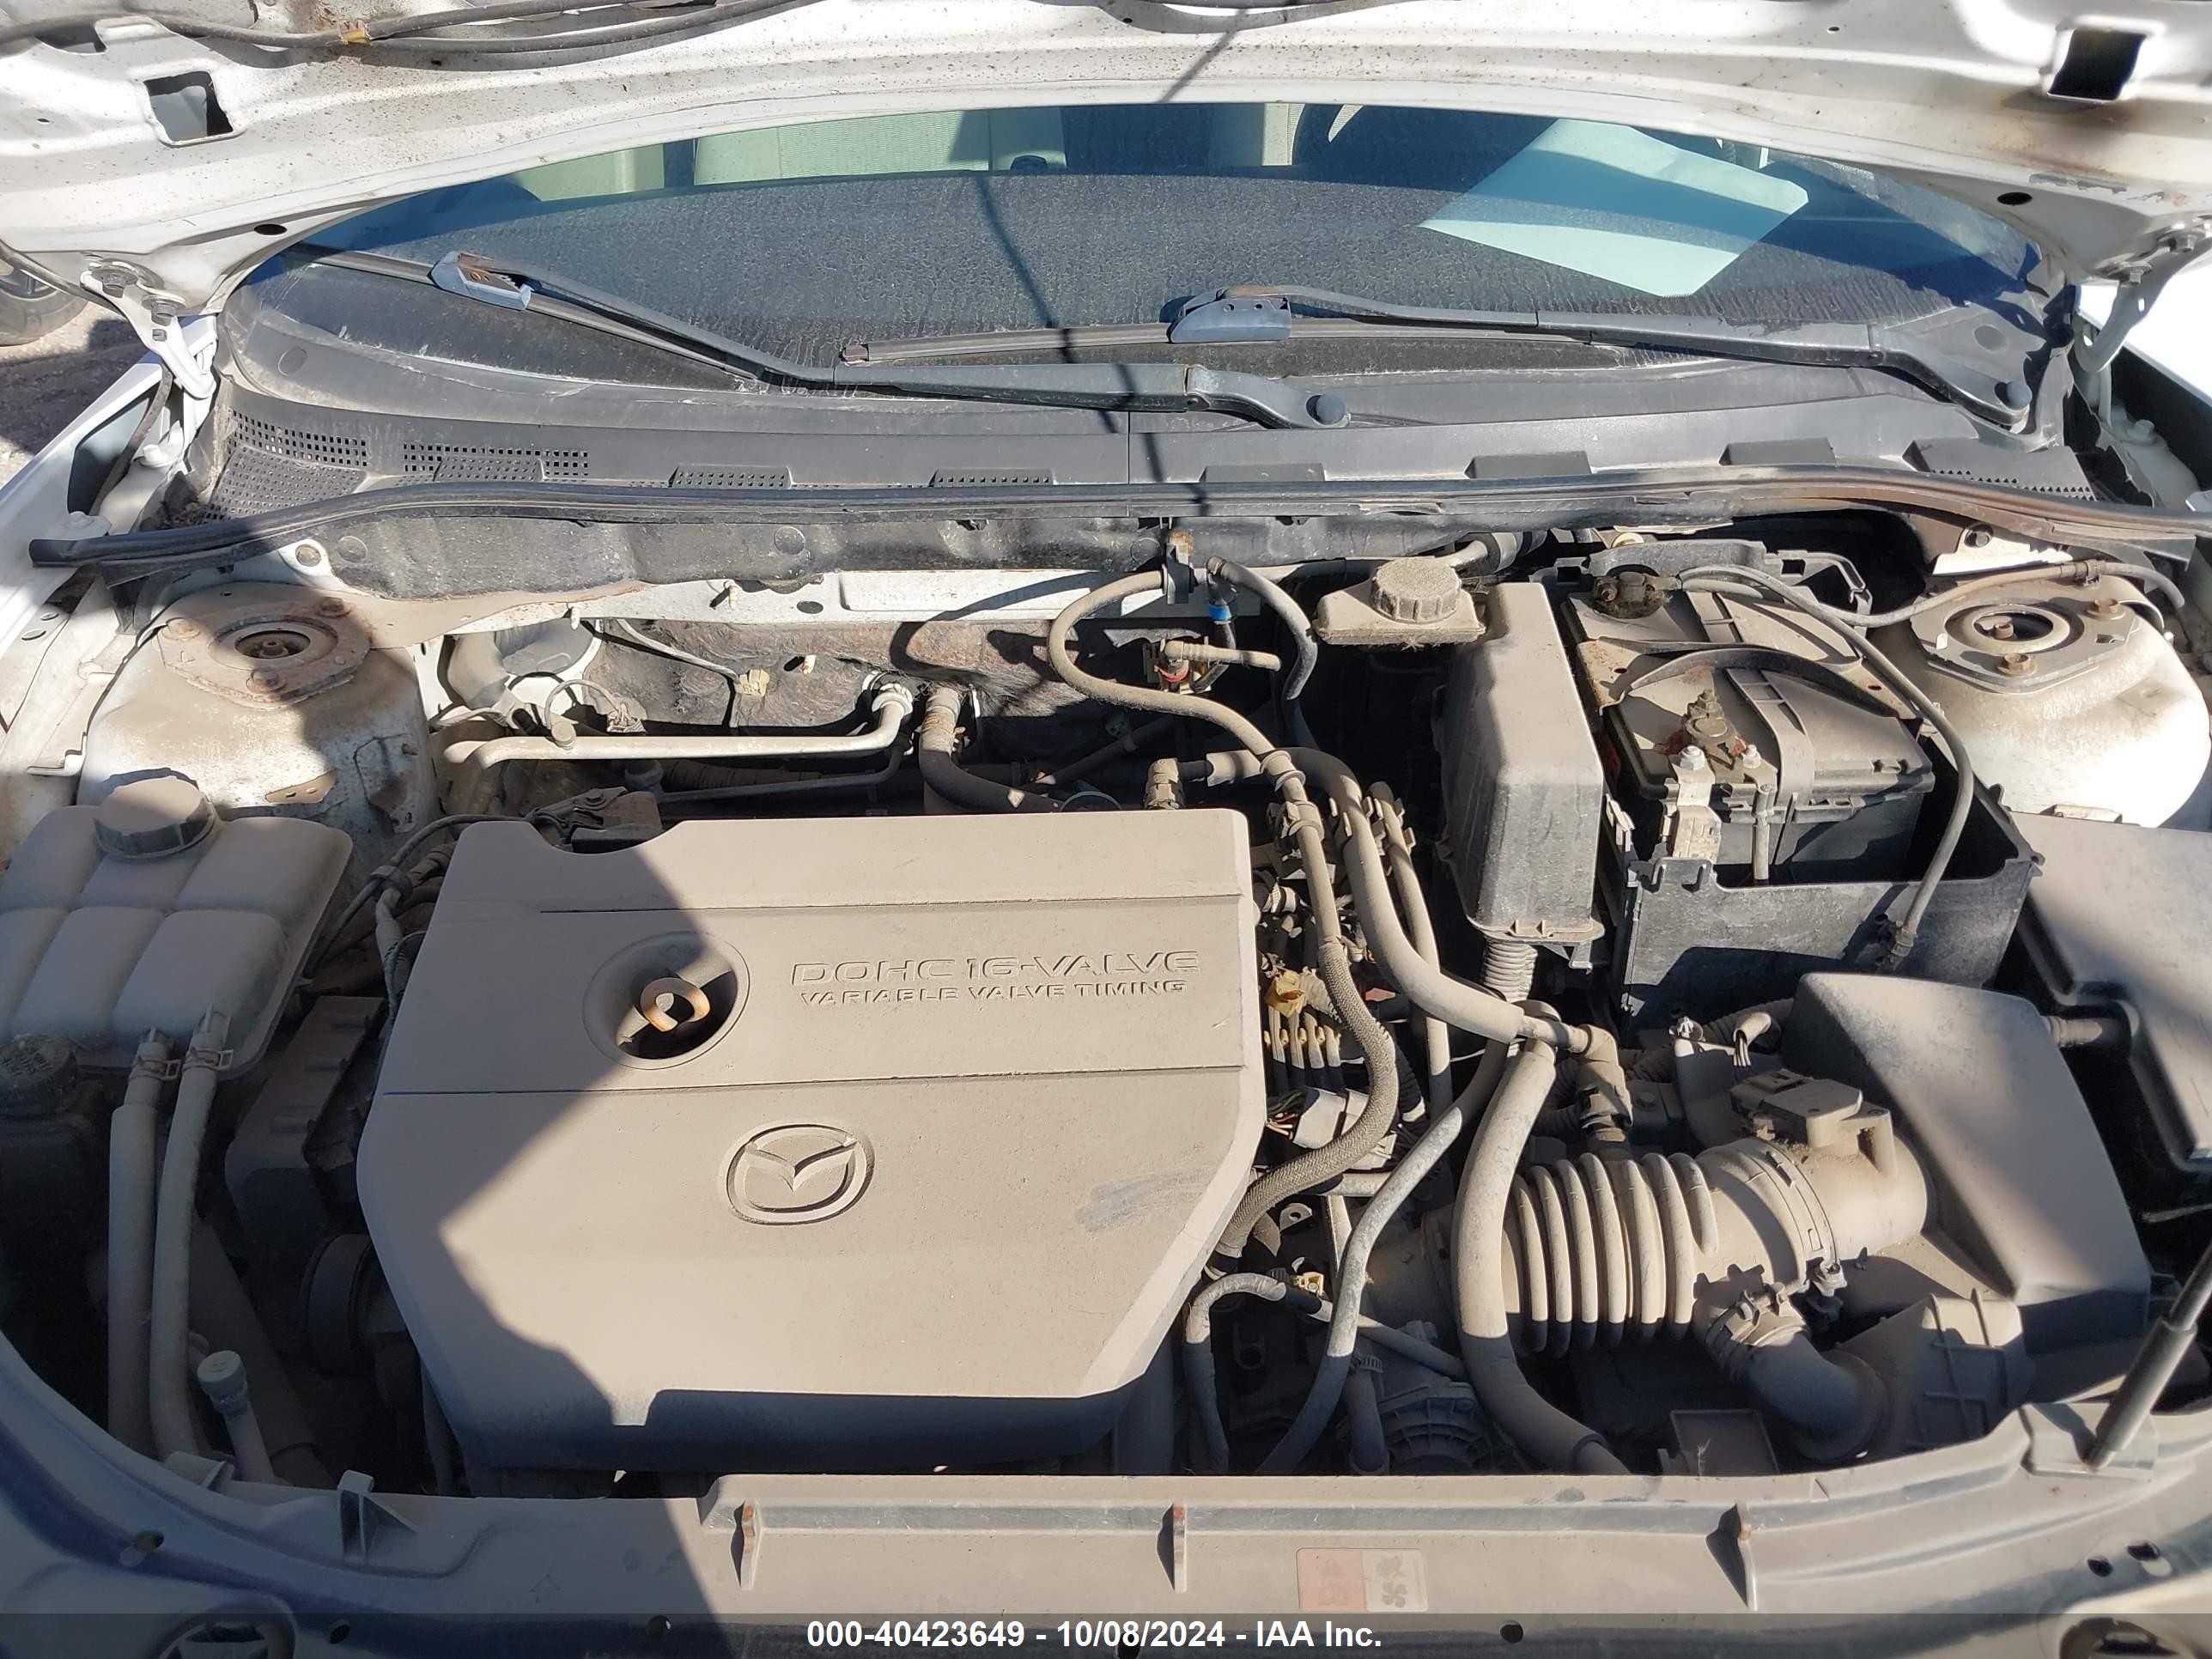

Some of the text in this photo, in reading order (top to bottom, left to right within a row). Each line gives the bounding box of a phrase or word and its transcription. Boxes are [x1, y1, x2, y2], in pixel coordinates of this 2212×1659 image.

[790, 950, 1200, 986] DOHC 16-VALVE
[800, 979, 1188, 1006] VARIABLE VALVE TIMING
